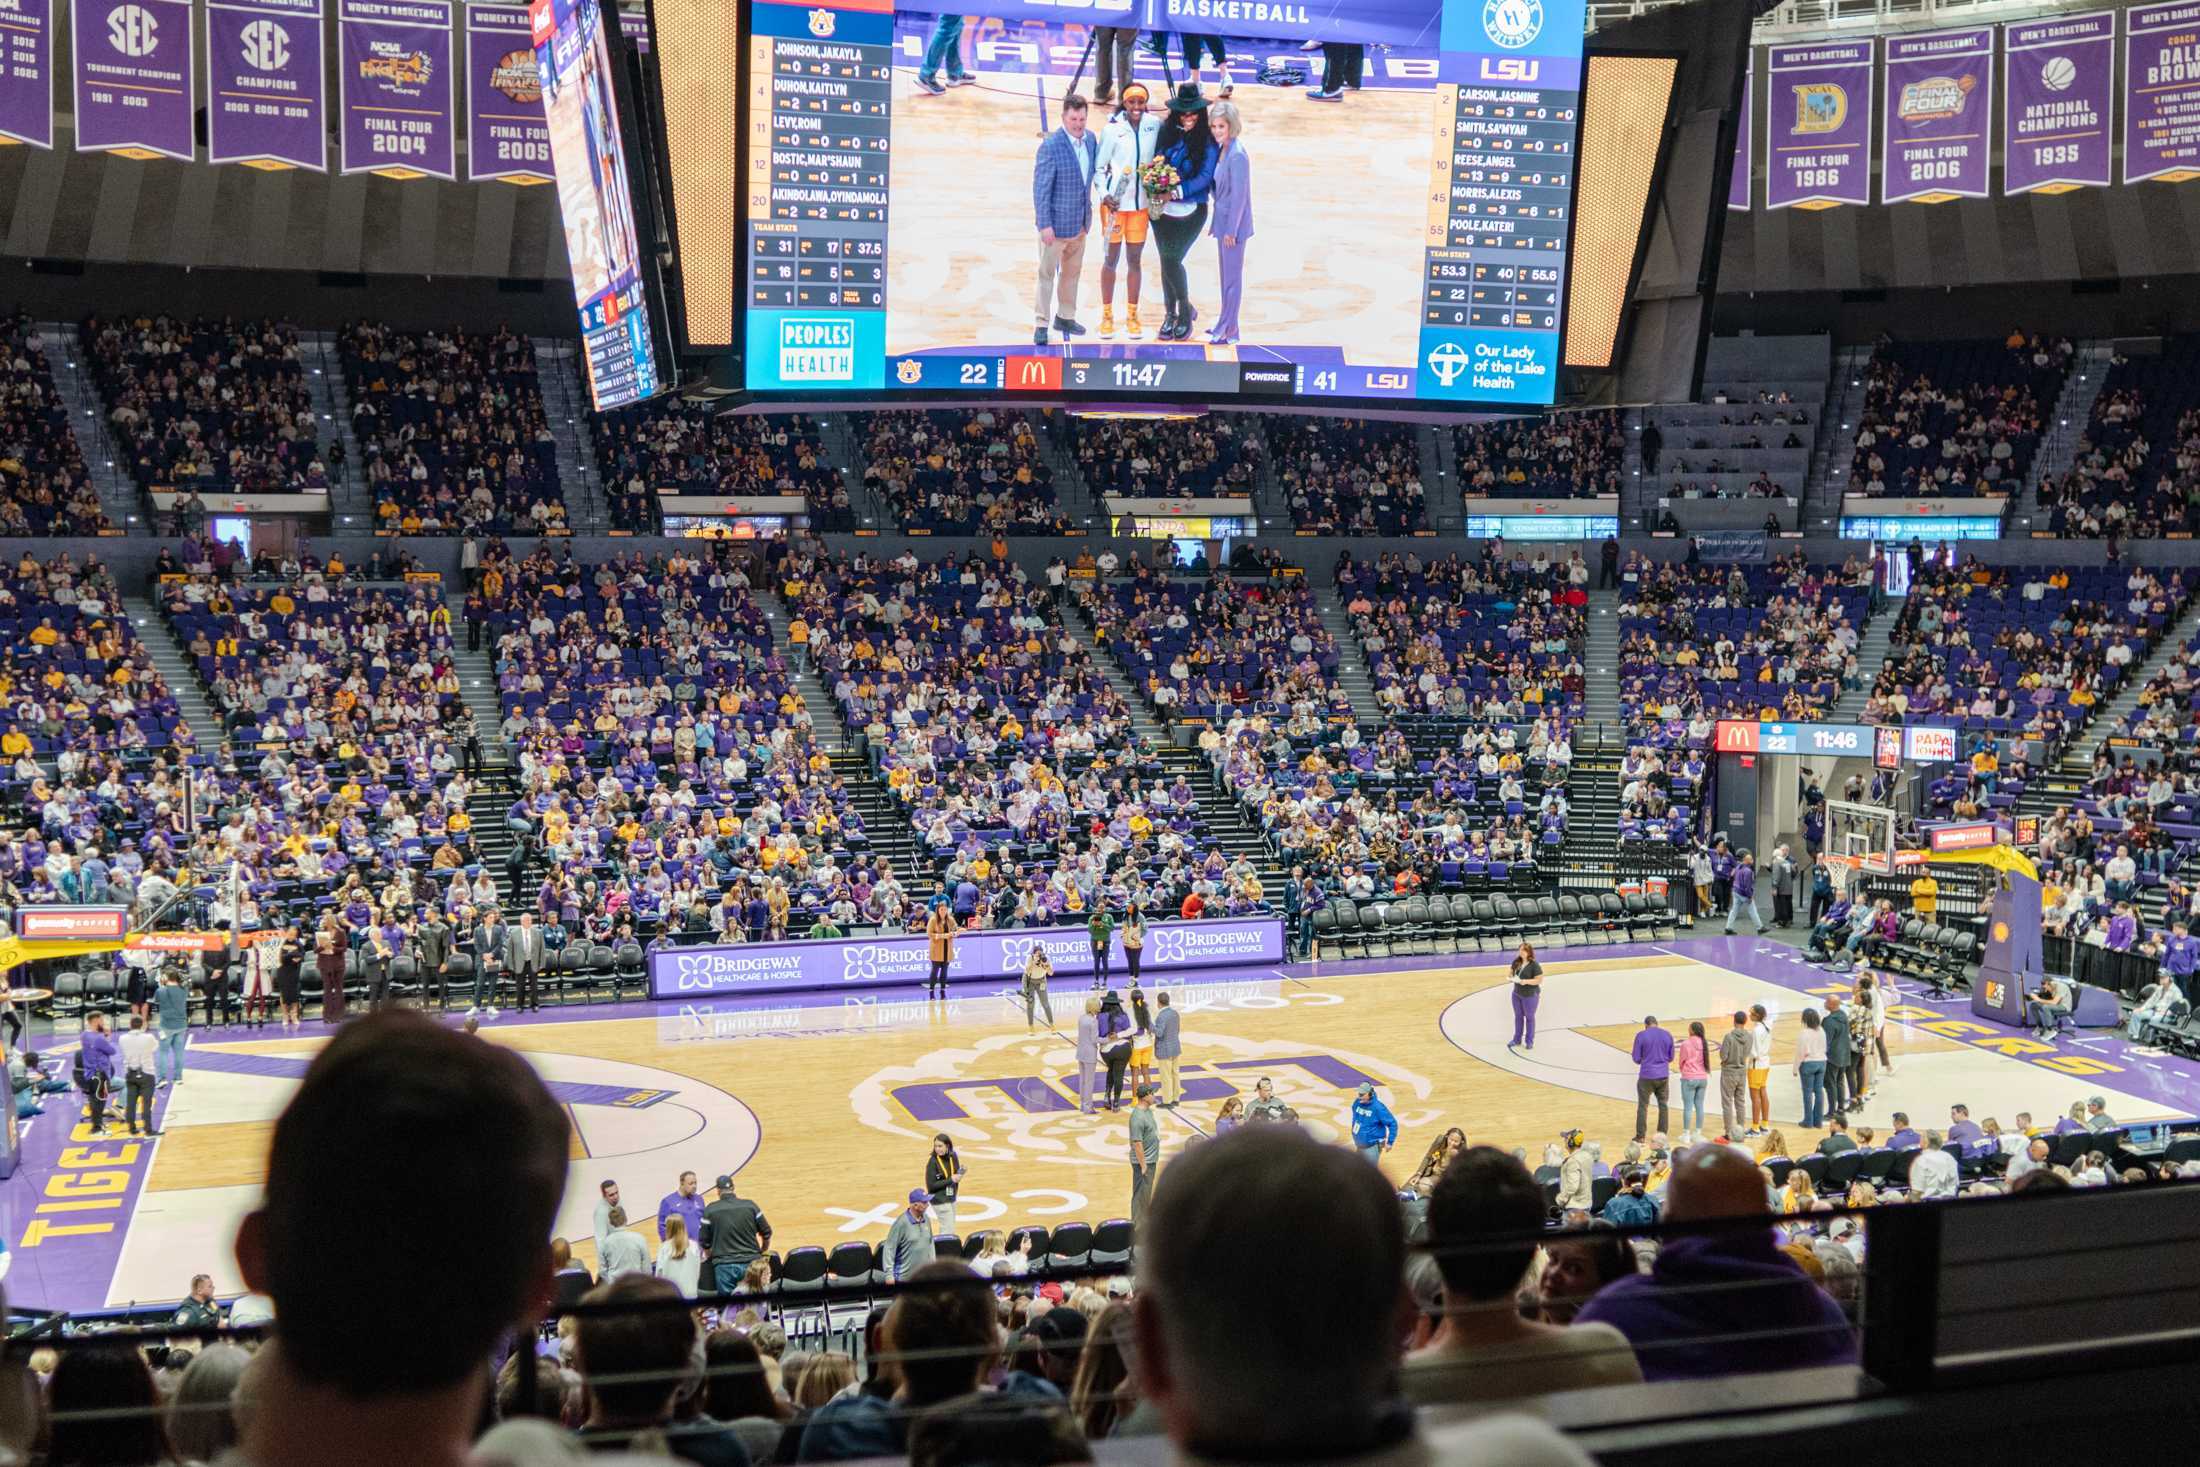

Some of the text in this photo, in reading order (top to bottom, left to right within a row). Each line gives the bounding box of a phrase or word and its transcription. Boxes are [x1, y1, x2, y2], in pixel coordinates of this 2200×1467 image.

[347, 2, 444, 19] WOMEN'S BASKETBALL
[1168, 0, 1310, 24] BASKETBALL
[475, 12, 516, 24] WOMEN'S
[2142, 13, 2169, 24] MEN'S
[106, 4, 159, 57] SEC
[2020, 22, 2099, 42] MEN'S BASKETBALL
[240, 20, 290, 71] SEC
[1900, 37, 1978, 53] MEN'S BASKETBALL
[2168, 34, 2197, 46] COACH
[1783, 49, 1859, 62] MEN'S BASKETBALL
[86, 63, 181, 81] TOURNAMENT CHAMPIONS
[792, 61, 889, 79] 0 2 1 0
[1480, 58, 1539, 81] LSU
[236, 76, 297, 91] CHAMPIONS
[1459, 88, 1540, 104] CARSON,JASMINE
[1919, 87, 1958, 98] FINAL
[791, 98, 886, 115] 2 1 0 1
[1904, 96, 1957, 111] FOUR
[2026, 100, 2090, 118] NATIONAL
[1475, 105, 1574, 120] 8 3 0 0
[365, 118, 433, 134] FINAL FOUR
[757, 123, 766, 133] 11
[2018, 112, 2098, 133] CHAMPIONS
[2148, 117, 2167, 127] NCAA
[490, 126, 523, 139] FINAL
[373, 134, 427, 155] 2004
[791, 134, 888, 151] 0 0 0 0
[1473, 138, 1568, 153] 0 0 0 1
[498, 142, 549, 160] 2005
[1904, 146, 1968, 161] FINAL FOUR
[2034, 144, 2079, 166] 1935
[2177, 147, 2197, 157] WINS
[755, 160, 766, 170] 12
[1437, 160, 1447, 169] 10
[1455, 154, 1516, 168] REESE,ANGEL
[1786, 154, 1849, 168] FINAL FOUR
[790, 170, 884, 186] 0 0 1 1
[1471, 170, 1566, 186] 13 9 0 1
[1911, 161, 1960, 181] 2006
[1796, 169, 1839, 188] 1986
[1432, 193, 1446, 202] 45
[1452, 186, 1522, 200] MORRIS,ALEXIS
[753, 196, 767, 206] 20
[790, 206, 884, 221] 2 2 0 1
[1468, 203, 1563, 218] 6 3 6 1
[1430, 226, 1444, 234] 55
[1450, 219, 1514, 233] POOLE,KATERI
[779, 240, 792, 253] 31
[827, 242, 838, 254] 17
[858, 243, 882, 255] 37.5
[1466, 235, 1561, 250] 6 1 1 1
[779, 266, 791, 278] 16
[830, 267, 838, 279] 5
[873, 268, 881, 280] 3
[1441, 265, 1466, 277] 53.3
[1497, 268, 1514, 279] 40
[1531, 269, 1557, 281] 55.6
[785, 291, 791, 303] 1
[829, 292, 838, 304] 8
[873, 293, 881, 305] 0
[1450, 289, 1465, 300] 22
[1505, 291, 1512, 302] 7
[1547, 293, 1555, 304] 4
[1455, 312, 1464, 322] 0
[1502, 314, 1510, 324] 6
[1544, 316, 1553, 326] 0
[785, 325, 850, 345] PEOPLES
[1475, 343, 1536, 361] Our Lady
[785, 354, 849, 373] HEALTH
[1474, 359, 1545, 376] of the Lake
[960, 363, 988, 385] 22
[1075, 371, 1086, 384] 3
[1112, 363, 1167, 387] 11:47
[1245, 372, 1290, 383] POWERADE
[1313, 371, 1337, 391] 41
[1366, 373, 1408, 390] LSU
[1472, 376, 1514, 389] Health
[1768, 736, 1787, 750] 22
[1814, 731, 1857, 748] 11:46
[2020, 830, 2033, 842] 30
[1185, 931, 1262, 946] BRIDGEWAY
[1186, 944, 1264, 956] HEALTHCARE HOSPICE
[713, 956, 801, 972] BRIDGEWAY
[877, 963, 923, 973] HEALTHCARE
[713, 970, 802, 982] HEALTHCARE HOSPICE
[890, 1054, 1389, 1122] LSU
